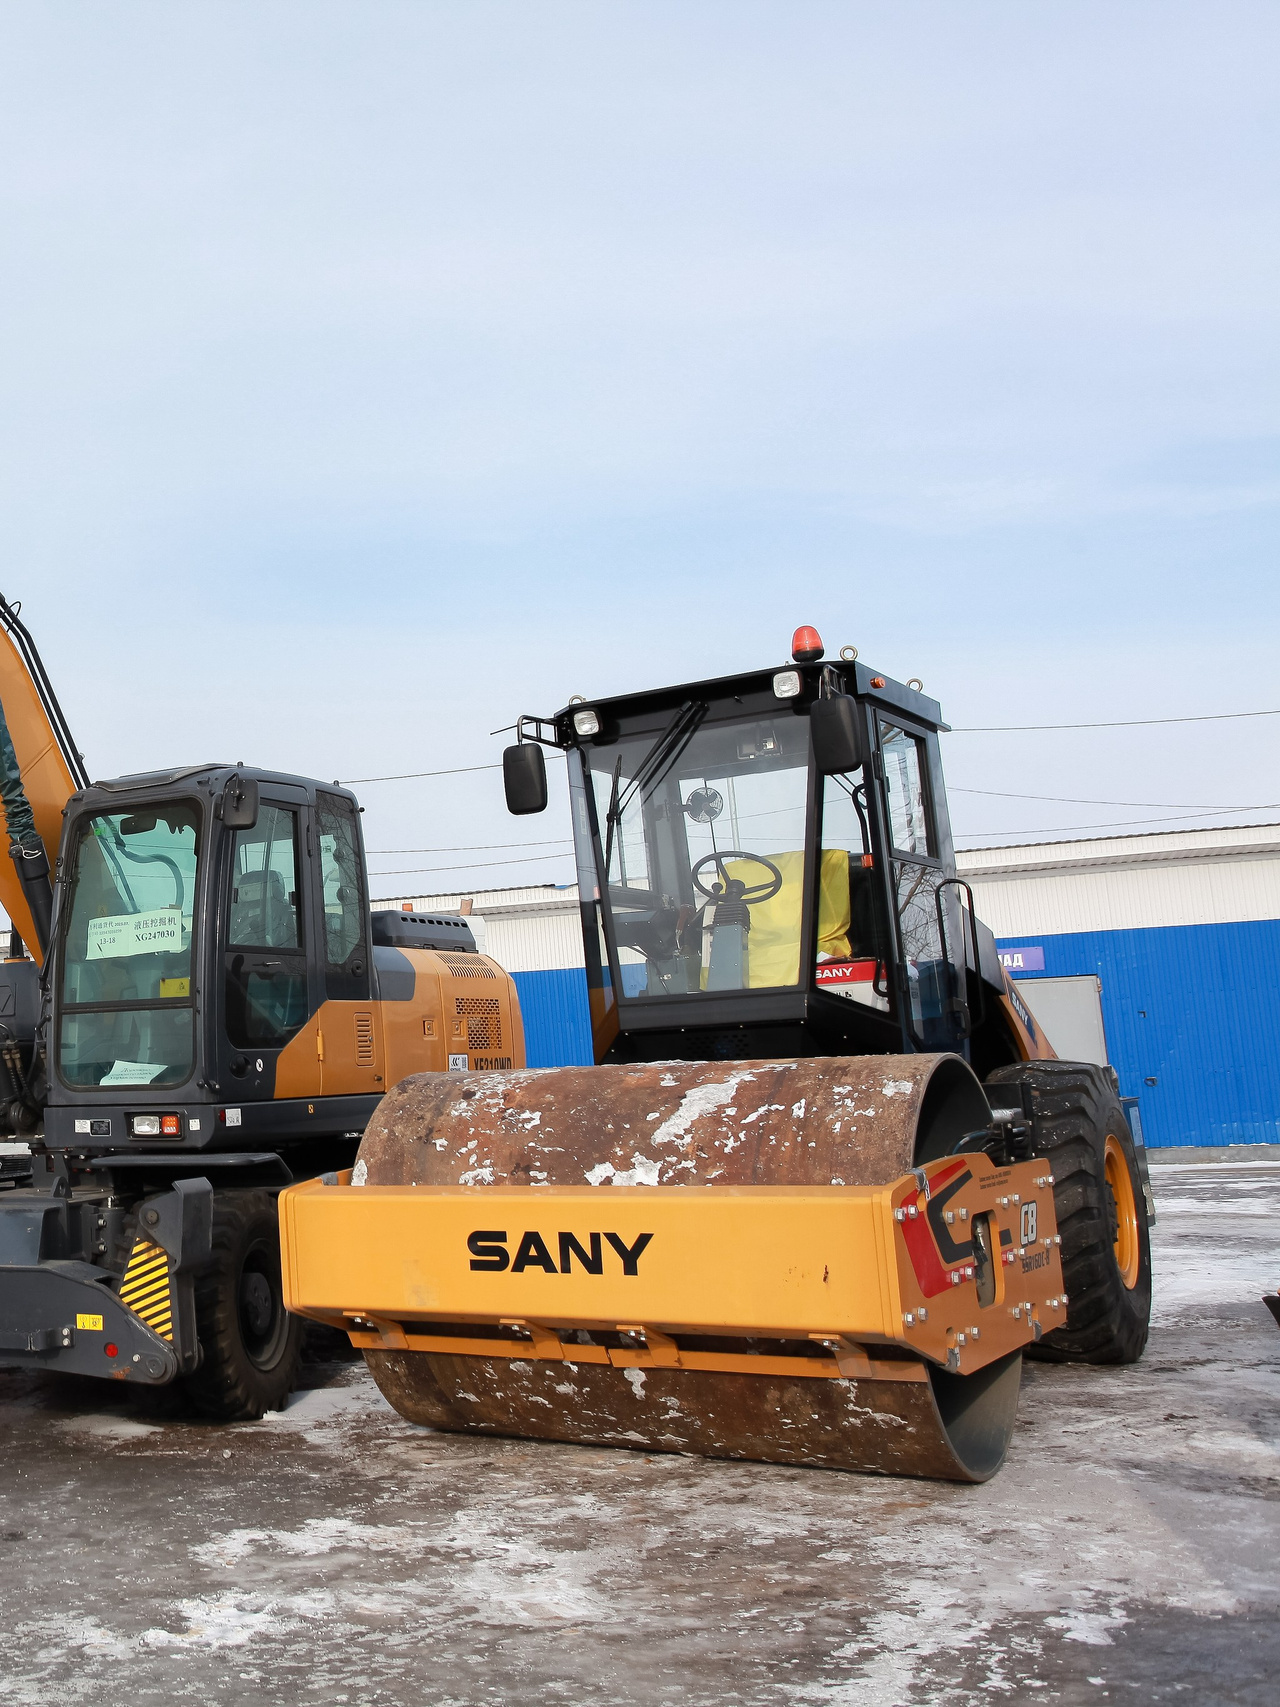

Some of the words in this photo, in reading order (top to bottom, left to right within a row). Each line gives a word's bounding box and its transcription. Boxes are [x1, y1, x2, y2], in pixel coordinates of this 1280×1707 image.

[134, 930, 175, 942] XG247030
[1011, 991, 1028, 1026] SANY
[466, 1230, 655, 1276] SANY
